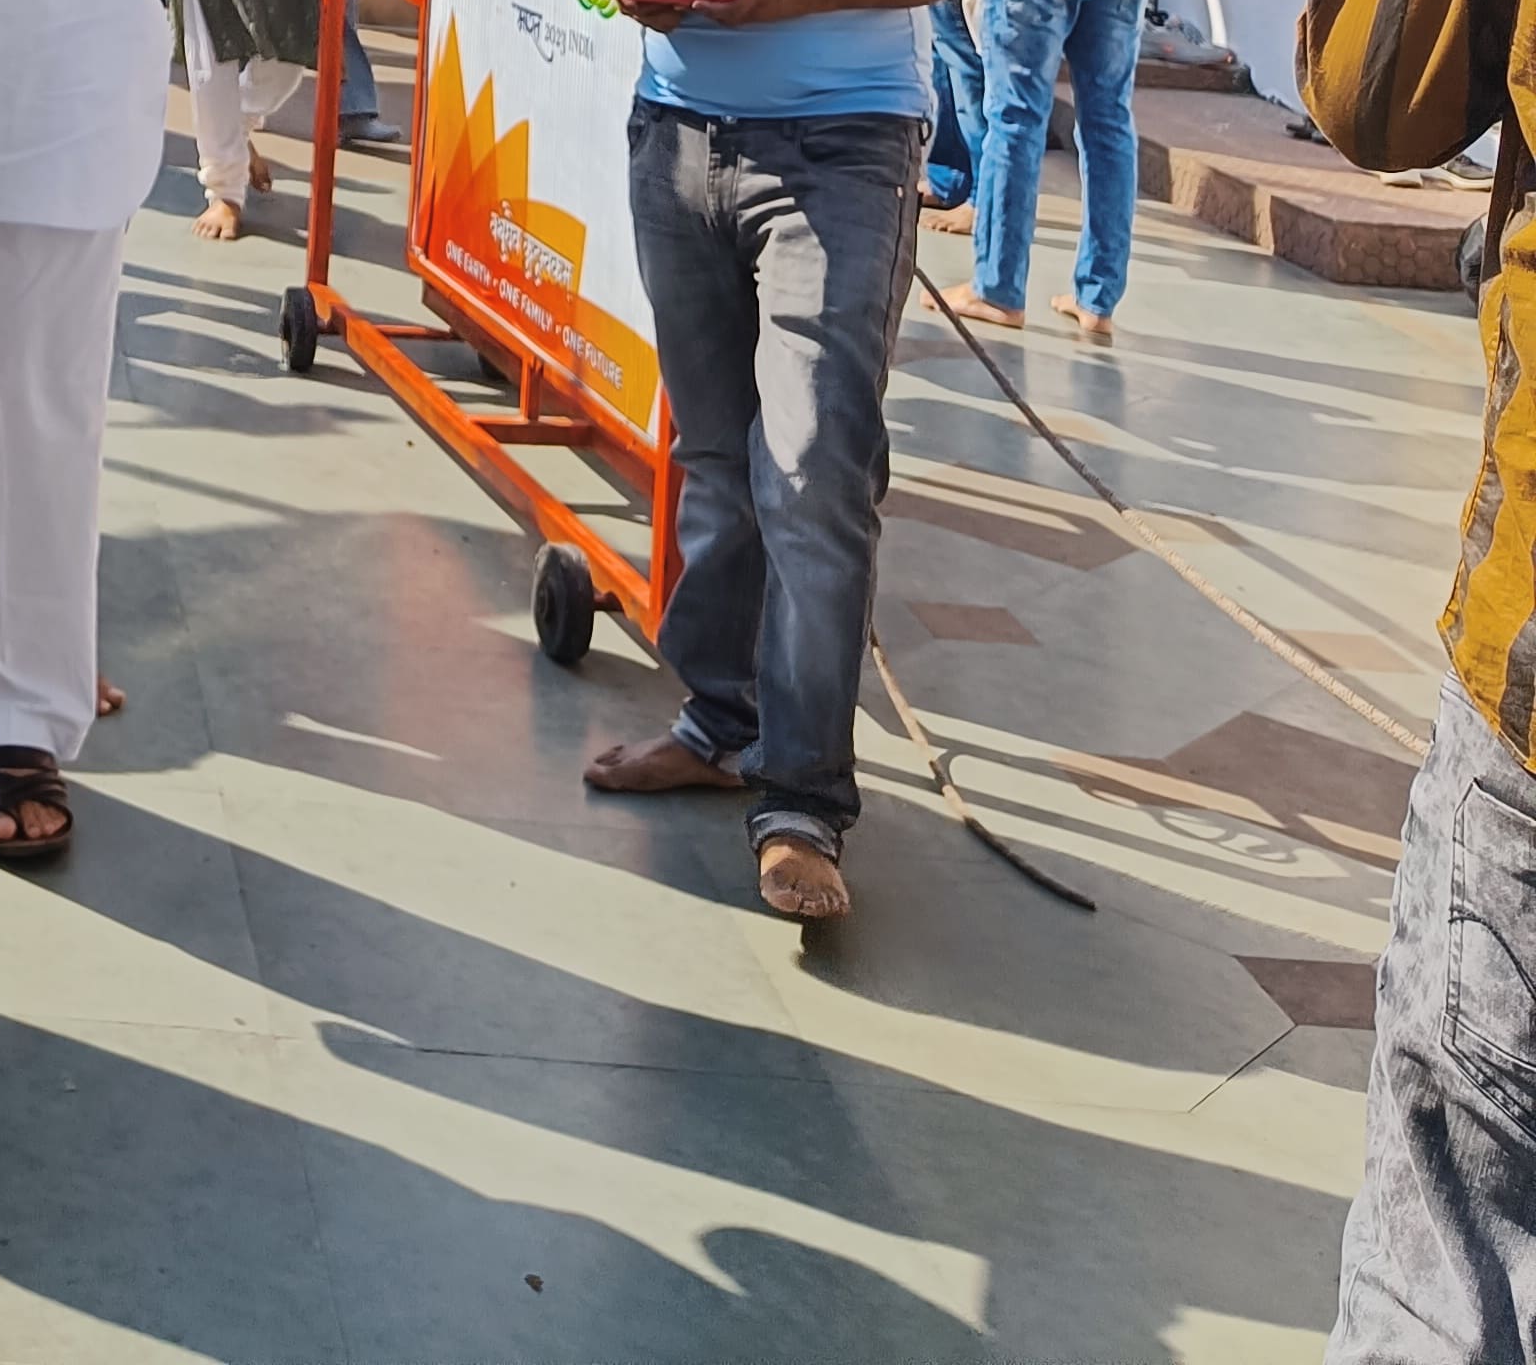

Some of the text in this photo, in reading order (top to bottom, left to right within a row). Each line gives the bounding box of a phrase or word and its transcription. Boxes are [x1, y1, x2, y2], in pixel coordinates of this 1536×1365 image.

[445, 239, 623, 390] ONE EARTH ONE FAMILY ONE FUTURE
